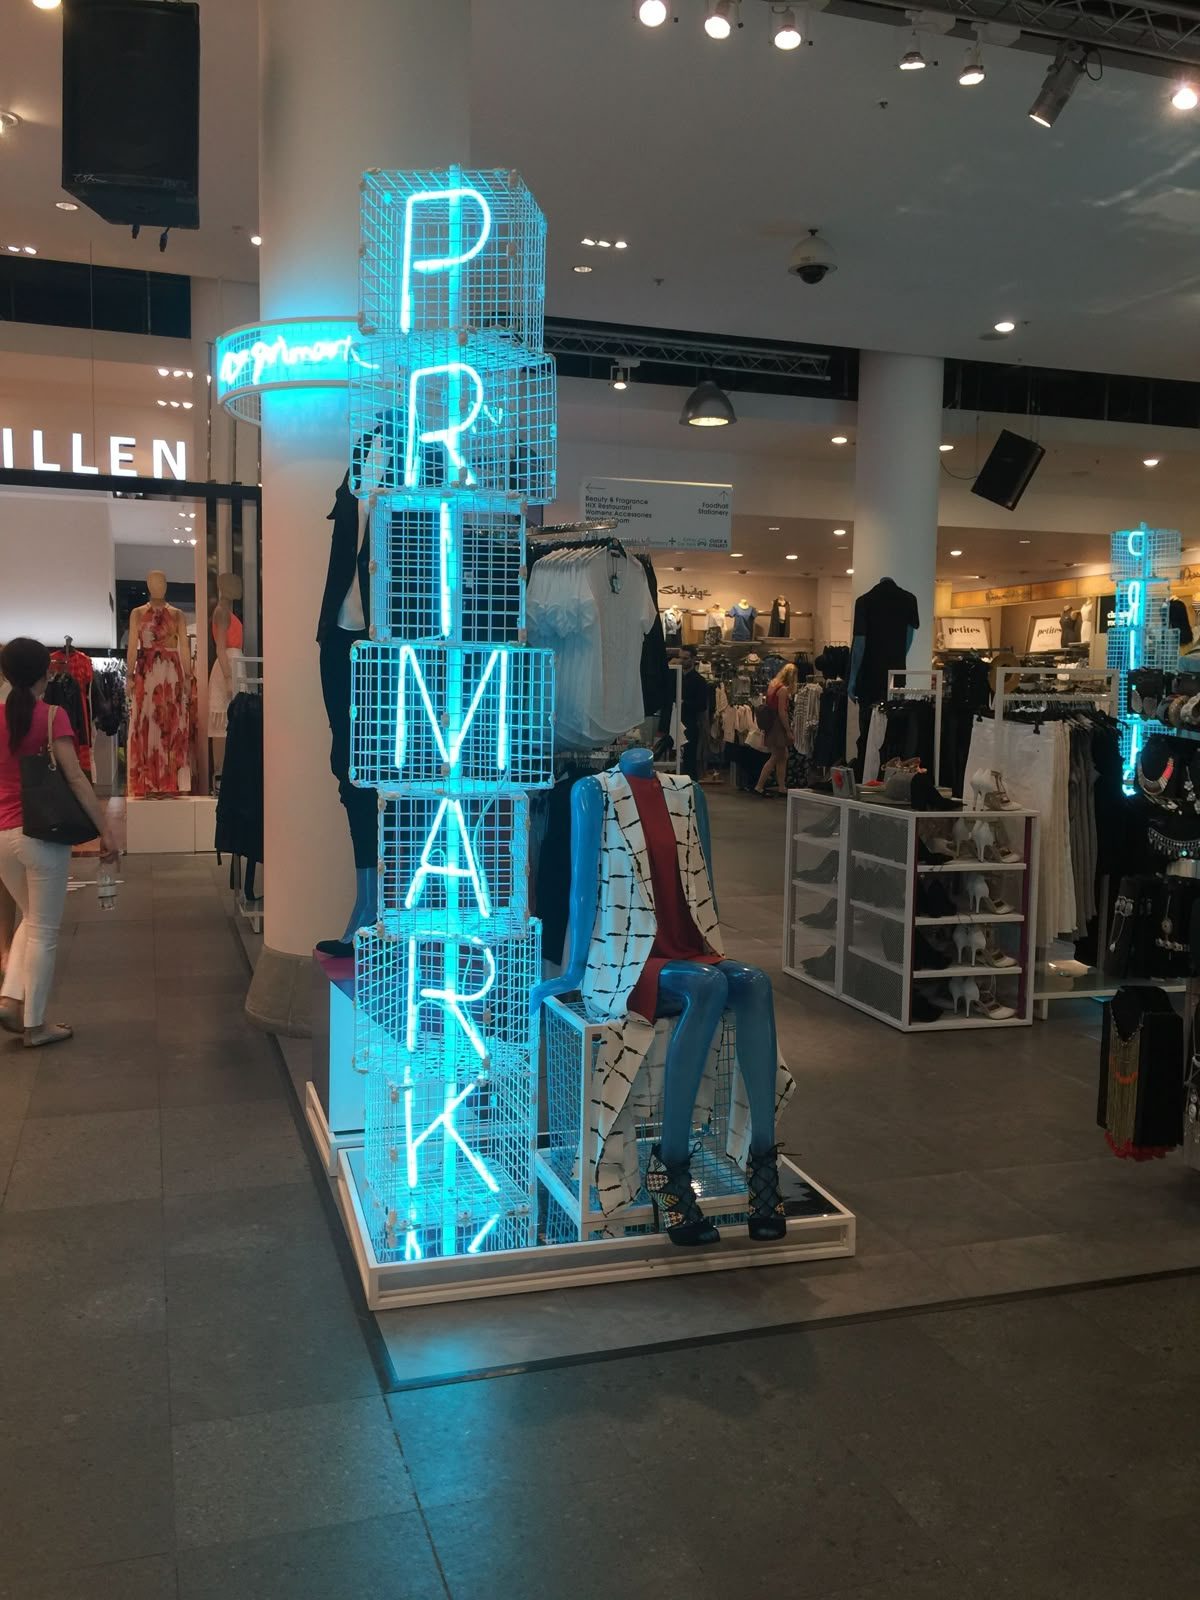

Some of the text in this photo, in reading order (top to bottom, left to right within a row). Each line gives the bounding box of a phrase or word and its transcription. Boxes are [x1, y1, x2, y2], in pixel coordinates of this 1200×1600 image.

[585, 495, 608, 503] Beauty
[615, 497, 649, 505] Fragrance
[598, 503, 632, 511] Restaurant
[614, 511, 652, 519] Accessories
[698, 508, 729, 517] Stationery
[948, 625, 981, 635] petites
